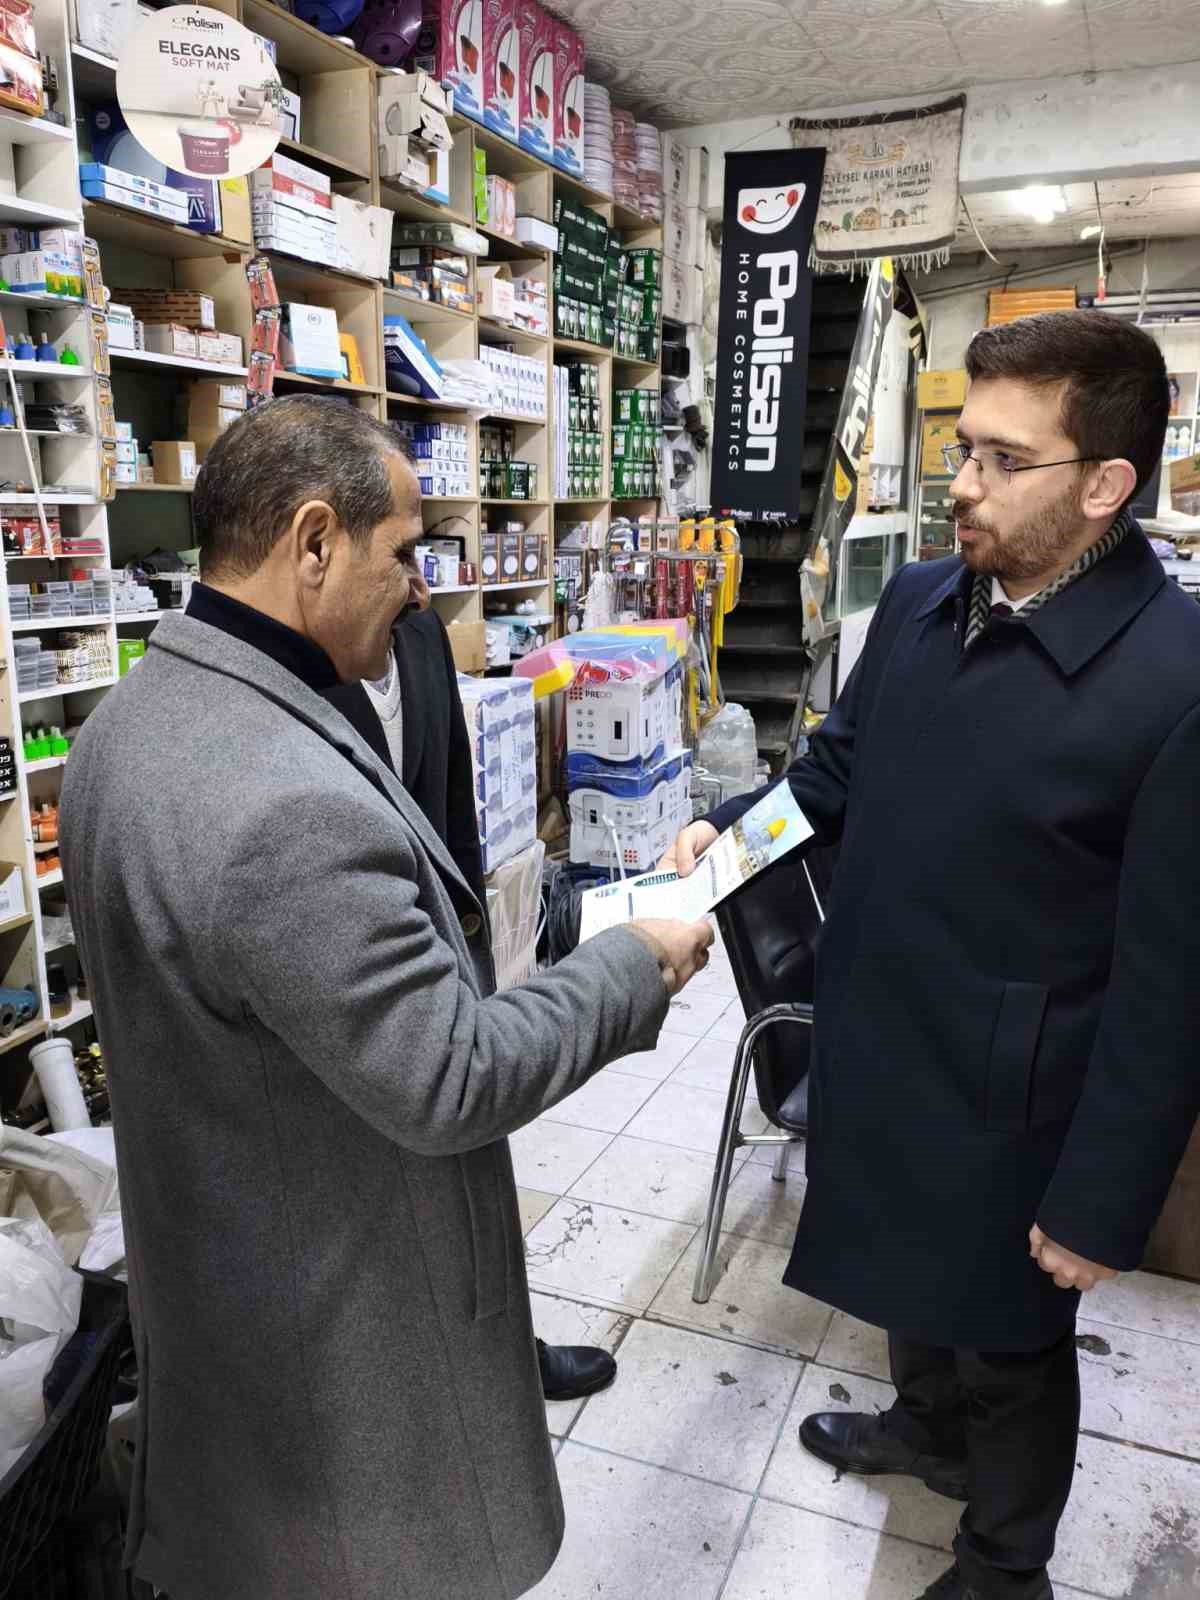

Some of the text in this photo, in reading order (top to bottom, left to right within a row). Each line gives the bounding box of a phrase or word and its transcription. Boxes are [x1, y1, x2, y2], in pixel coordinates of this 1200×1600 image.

[187, 16, 224, 31] Polisan
[158, 40, 241, 62] ELEGANS
[171, 56, 231, 73] SOFT MAT
[728, 253, 751, 471] HOME COSMETICS
[744, 250, 799, 472] Polisan
